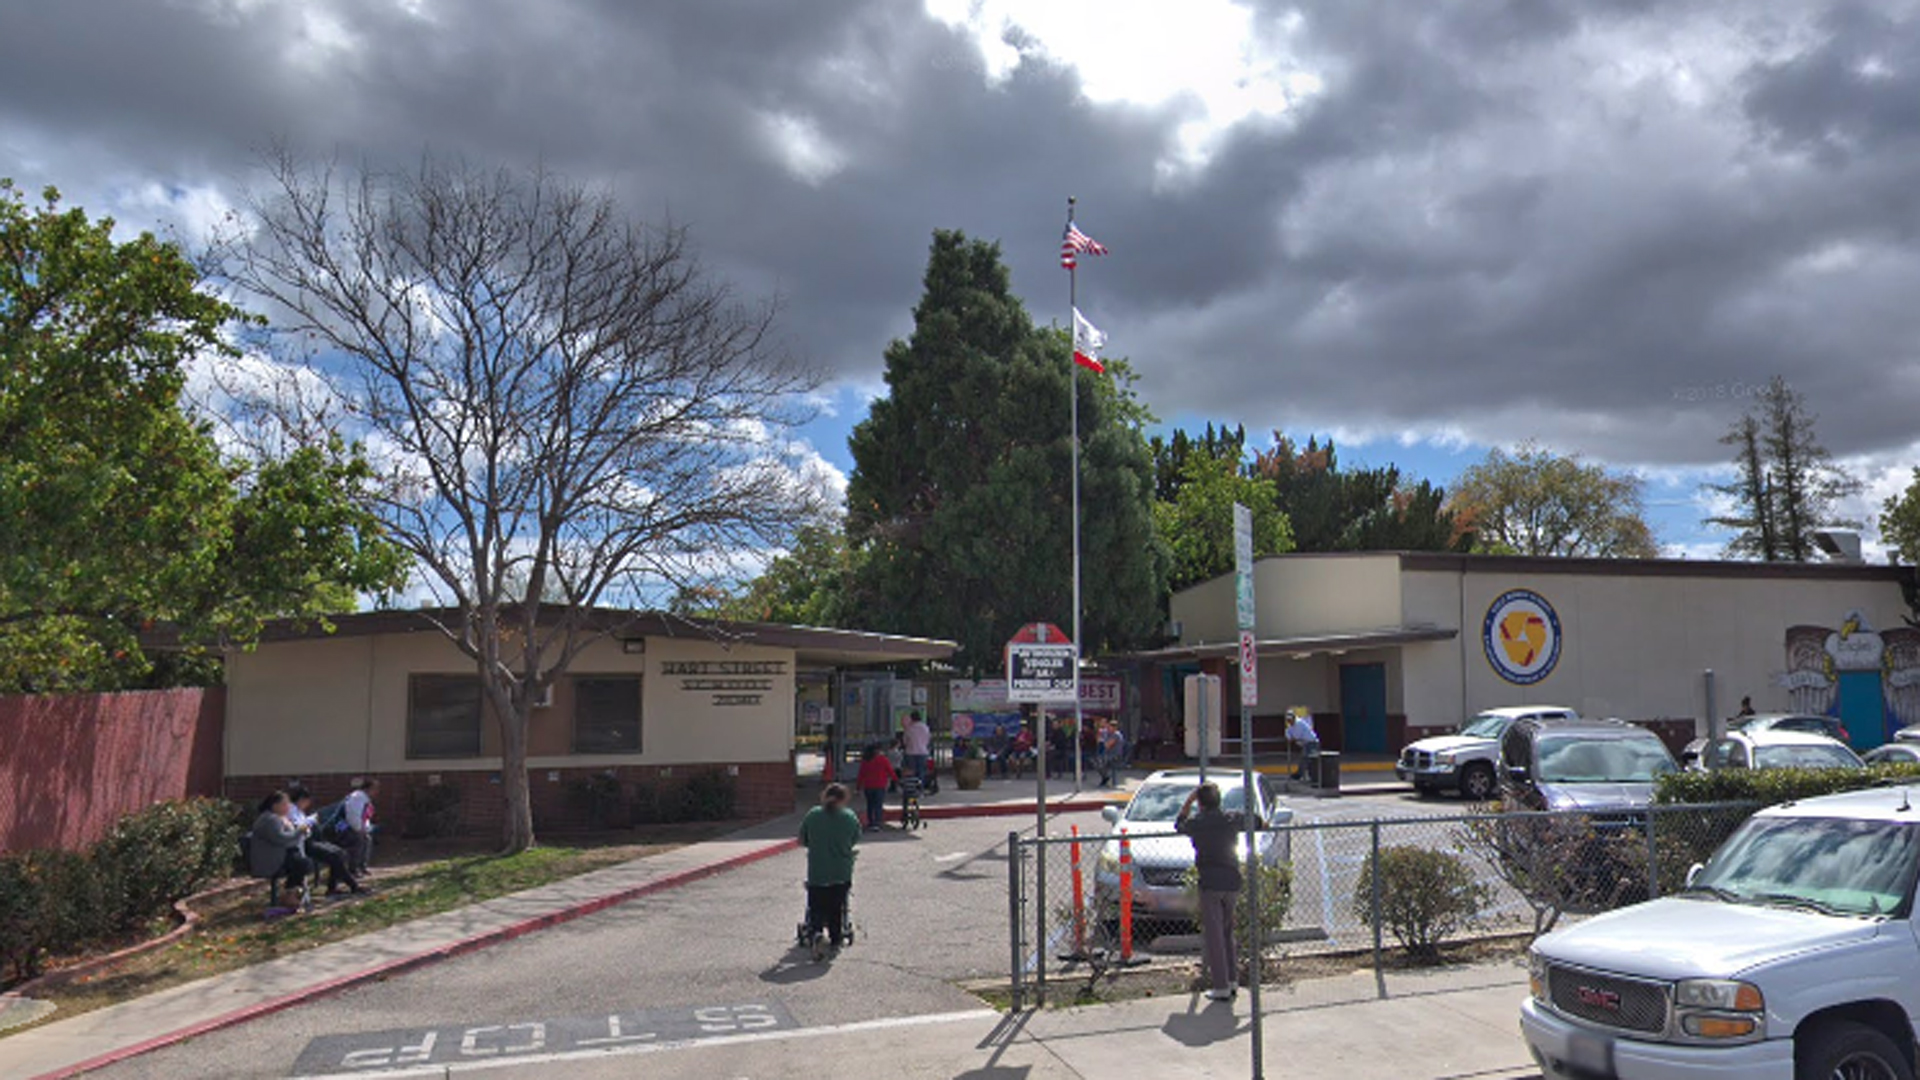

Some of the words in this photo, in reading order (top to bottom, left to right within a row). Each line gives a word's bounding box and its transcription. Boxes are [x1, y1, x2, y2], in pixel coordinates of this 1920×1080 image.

[661, 661, 709, 675] HART
[718, 661, 787, 675] STREET
[1079, 684, 1117, 698] BEST
[1576, 985, 1620, 1011] GMC
